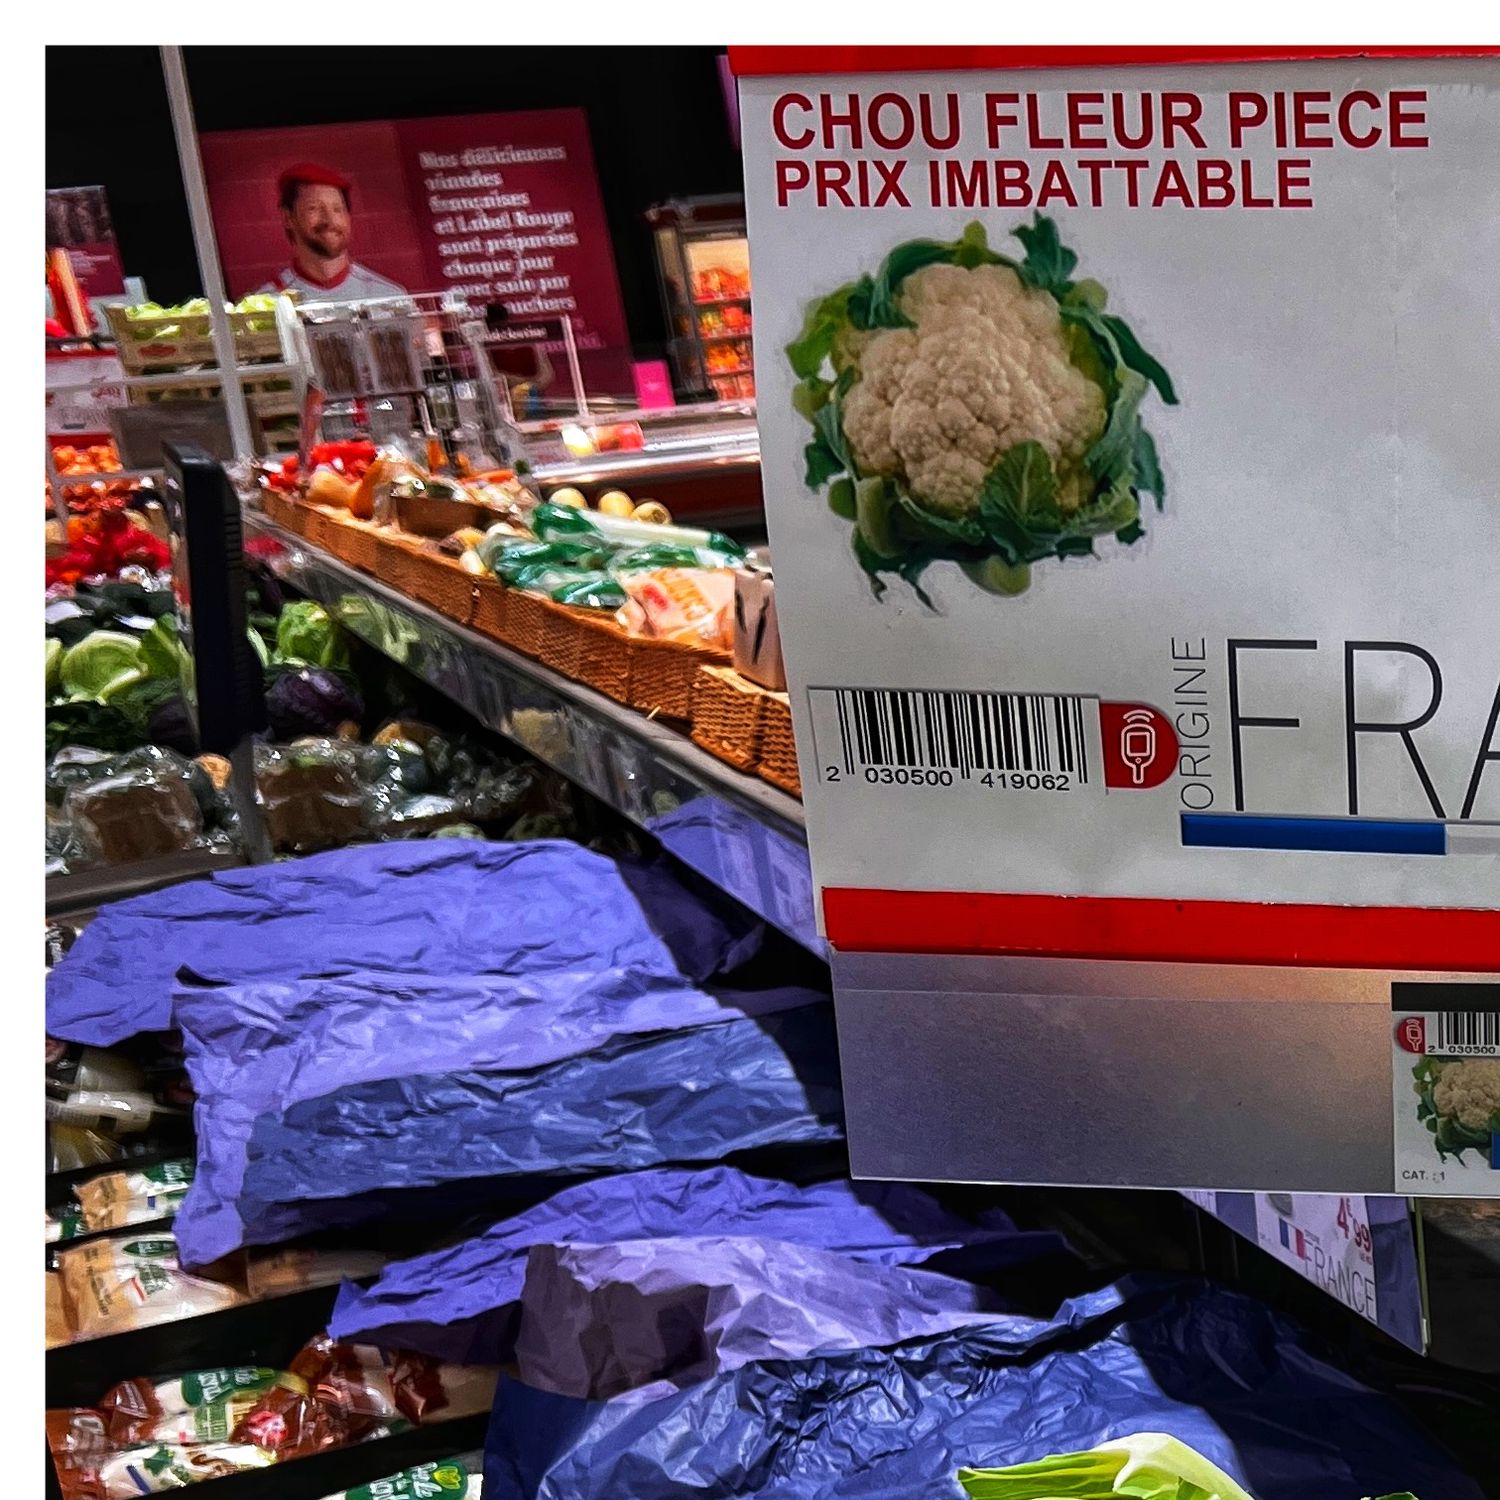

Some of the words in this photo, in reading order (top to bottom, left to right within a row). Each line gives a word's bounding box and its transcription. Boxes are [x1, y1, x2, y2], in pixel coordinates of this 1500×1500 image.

[773, 92, 959, 150] CHOU
[986, 92, 1208, 150] FLEUR
[1230, 90, 1429, 149] PIECE
[776, 160, 911, 208] PRIX
[929, 159, 1313, 208] IMBATTABLE
[456, 212, 511, 233] Label
[1171, 637, 1214, 810] ORIGINE
[826, 766, 841, 782] 2
[864, 768, 954, 787] 030500
[980, 773, 1070, 791] 419062
[1428, 1045, 1436, 1053] 2
[1448, 1046, 1496, 1054] 030500
[1402, 1170, 1429, 1180] CAT.
[1439, 1171, 1446, 1180] 1
[1337, 1197, 1349, 1239] 4
[1353, 1218, 1371, 1252] 99
[1304, 1238, 1376, 1322] FRANCE
